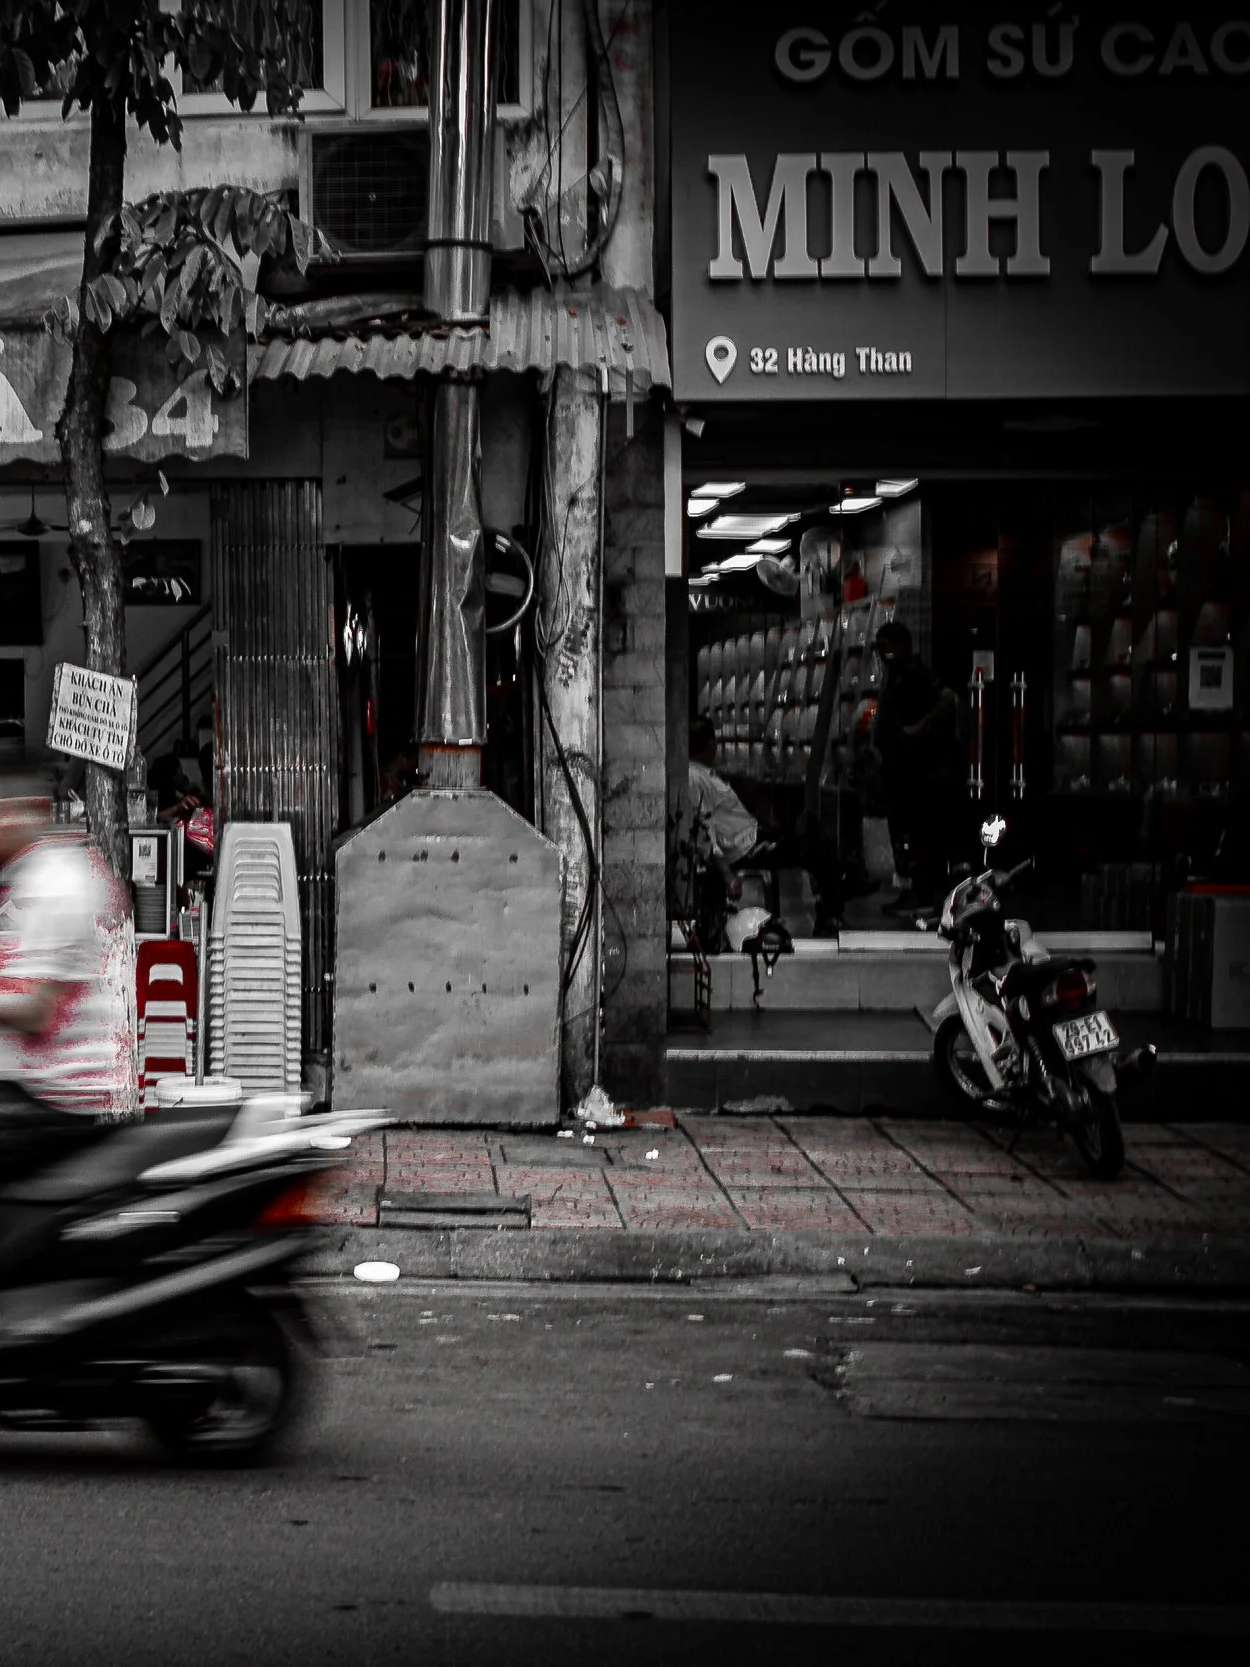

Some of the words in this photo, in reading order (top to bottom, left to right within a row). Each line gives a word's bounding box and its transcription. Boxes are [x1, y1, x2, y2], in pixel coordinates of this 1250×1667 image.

[774, 0, 960, 83] GỐM
[987, 4, 1080, 79] SỨ
[708, 150, 1050, 280] MINH
[1089, 144, 1250, 276] LO
[750, 347, 778, 374] 32
[787, 346, 846, 378] Hàng
[856, 346, 912, 374] Than
[71, 671, 107, 693] KHÁCH
[72, 689, 92, 709] BÚN
[59, 715, 91, 737] KHÁCH
